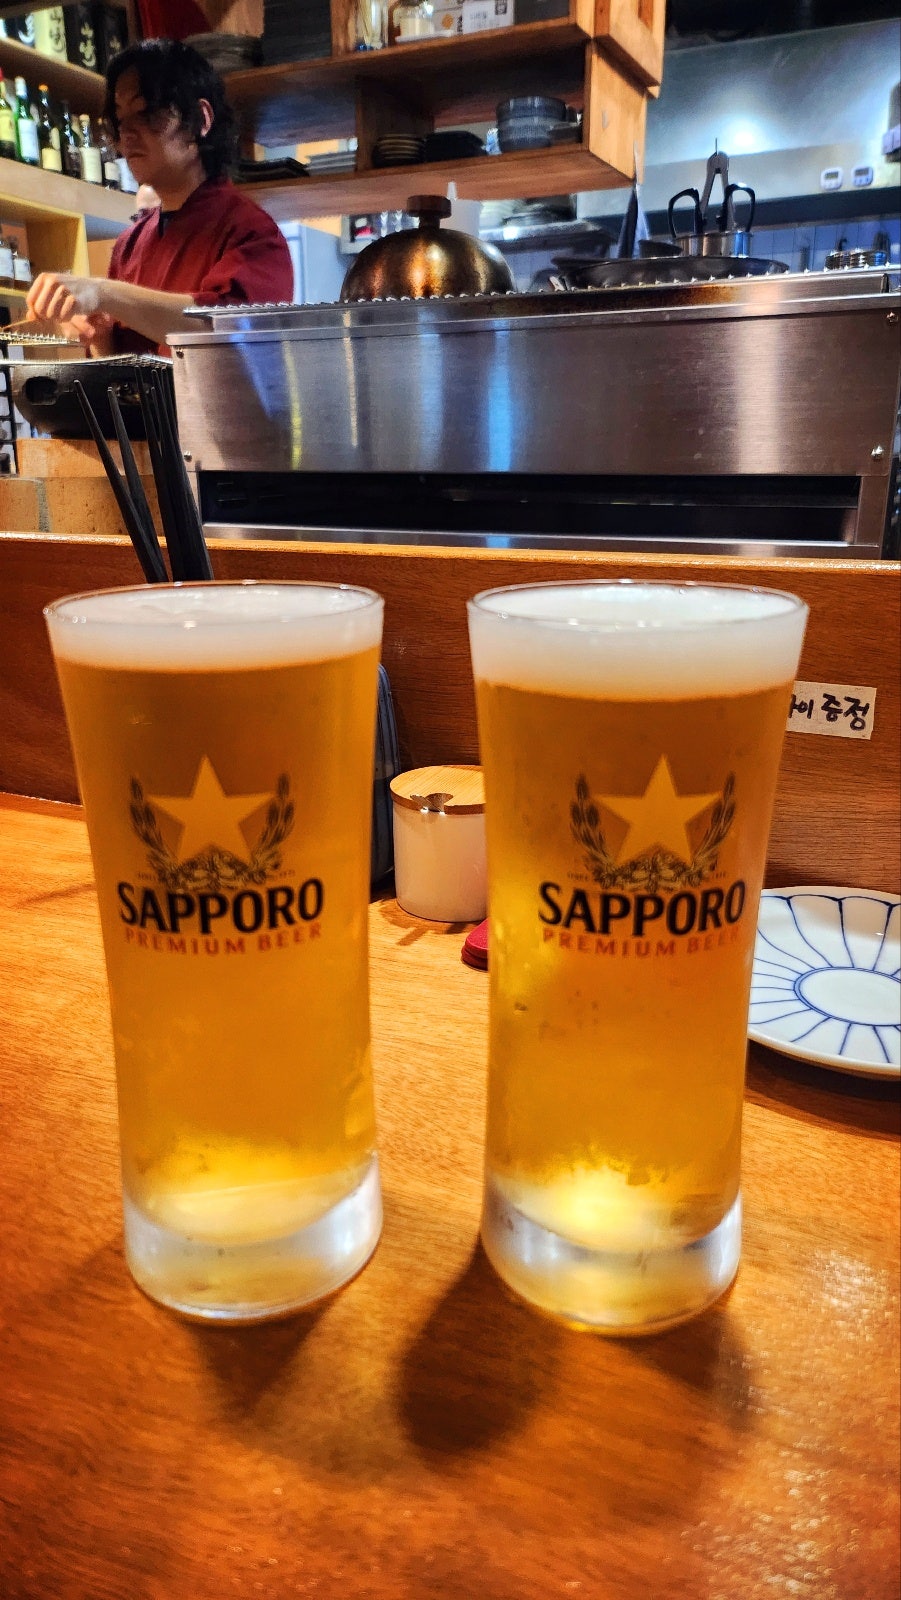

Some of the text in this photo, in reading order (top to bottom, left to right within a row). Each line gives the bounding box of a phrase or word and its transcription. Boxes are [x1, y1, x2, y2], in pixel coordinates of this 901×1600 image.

[821, 693, 870, 731] 증정
[117, 878, 324, 935] SAPPORO
[538, 879, 746, 937] SAPPORO
[125, 922, 322, 957] PREMIUM BEER
[542, 926, 739, 957] PREMIUM BEER
